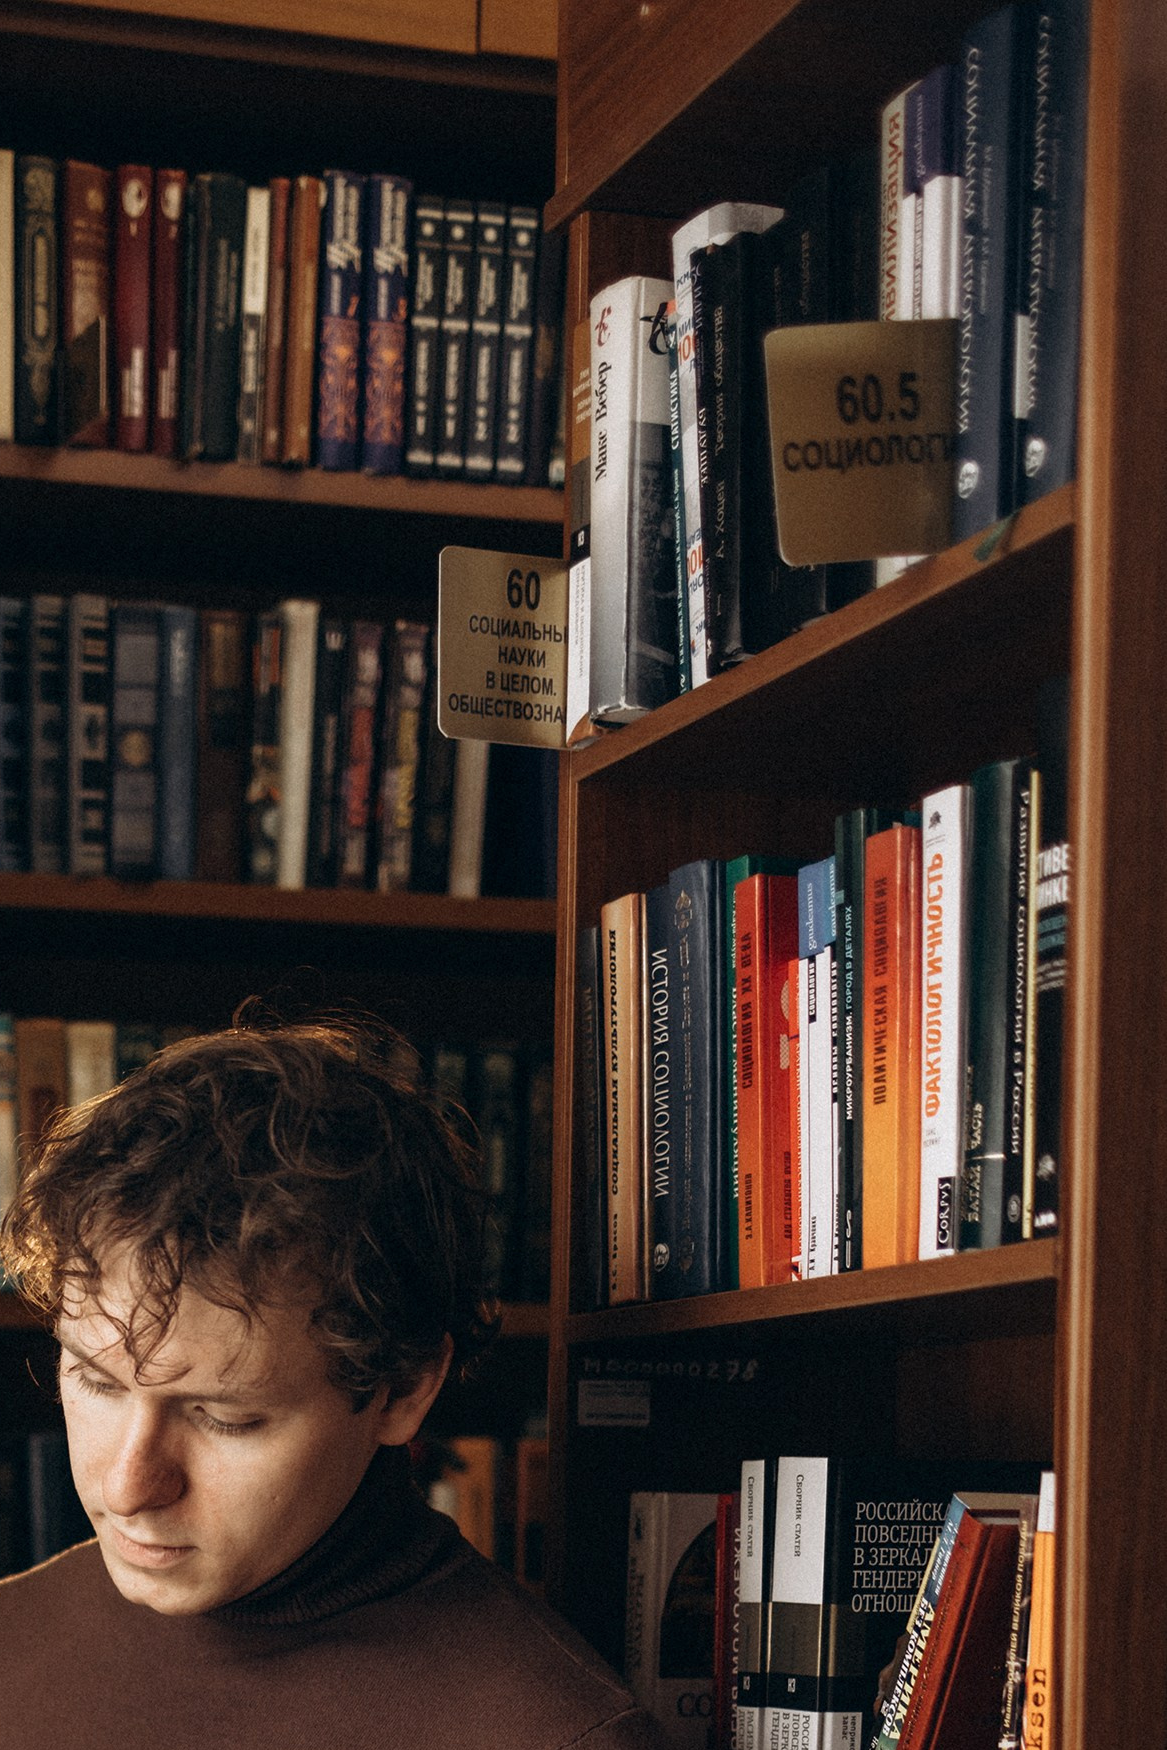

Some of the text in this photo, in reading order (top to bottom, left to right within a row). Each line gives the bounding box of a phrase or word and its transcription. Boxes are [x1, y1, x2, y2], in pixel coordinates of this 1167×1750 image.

[594, 360, 612, 481] Макс Вебер
[669, 369, 680, 450] СТАТИСТИКА
[837, 372, 921, 424] 60.5
[507, 569, 541, 610] 60
[486, 671, 557, 696] В ЦЕЛОМ.
[498, 645, 546, 668] НАУКИ
[1019, 788, 1031, 898] Развитие
[741, 932, 752, 968] ВЕКА
[805, 883, 818, 951] gaudeamus
[845, 906, 853, 959] ДЕТАЛЯХ
[609, 929, 618, 1073] КУЛЬТУРОЛОГИЯ
[807, 962, 817, 1016] СОЦИОЛОГИЯ
[845, 971, 853, 1010] ГОРОД
[873, 876, 888, 1105] ПОЛИТИЧЕСКАЯ СОЦИОЛОГИЯ
[925, 853, 943, 1118] ФАКТОЛОГИЧНОСТЬ
[1012, 901, 1027, 1044] социологии
[651, 948, 670, 1198] ИСТОРИЯ СОЦИОЛОГИИ
[741, 1001, 755, 1090] СОЦИОЛОГИЯ
[845, 1012, 853, 1121] МИКРОУРБАНИЗМ.
[611, 1079, 620, 1196] СОЦИАЛЬНАЯ
[1010, 1070, 1024, 1156] России
[853, 1547, 865, 1566] В
[881, 1597, 930, 1738] БЕЗ КОМПЛЕКСОВ
[888, 1603, 936, 1741] АМЕРИКА
[841, 1716, 849, 1741] запас
